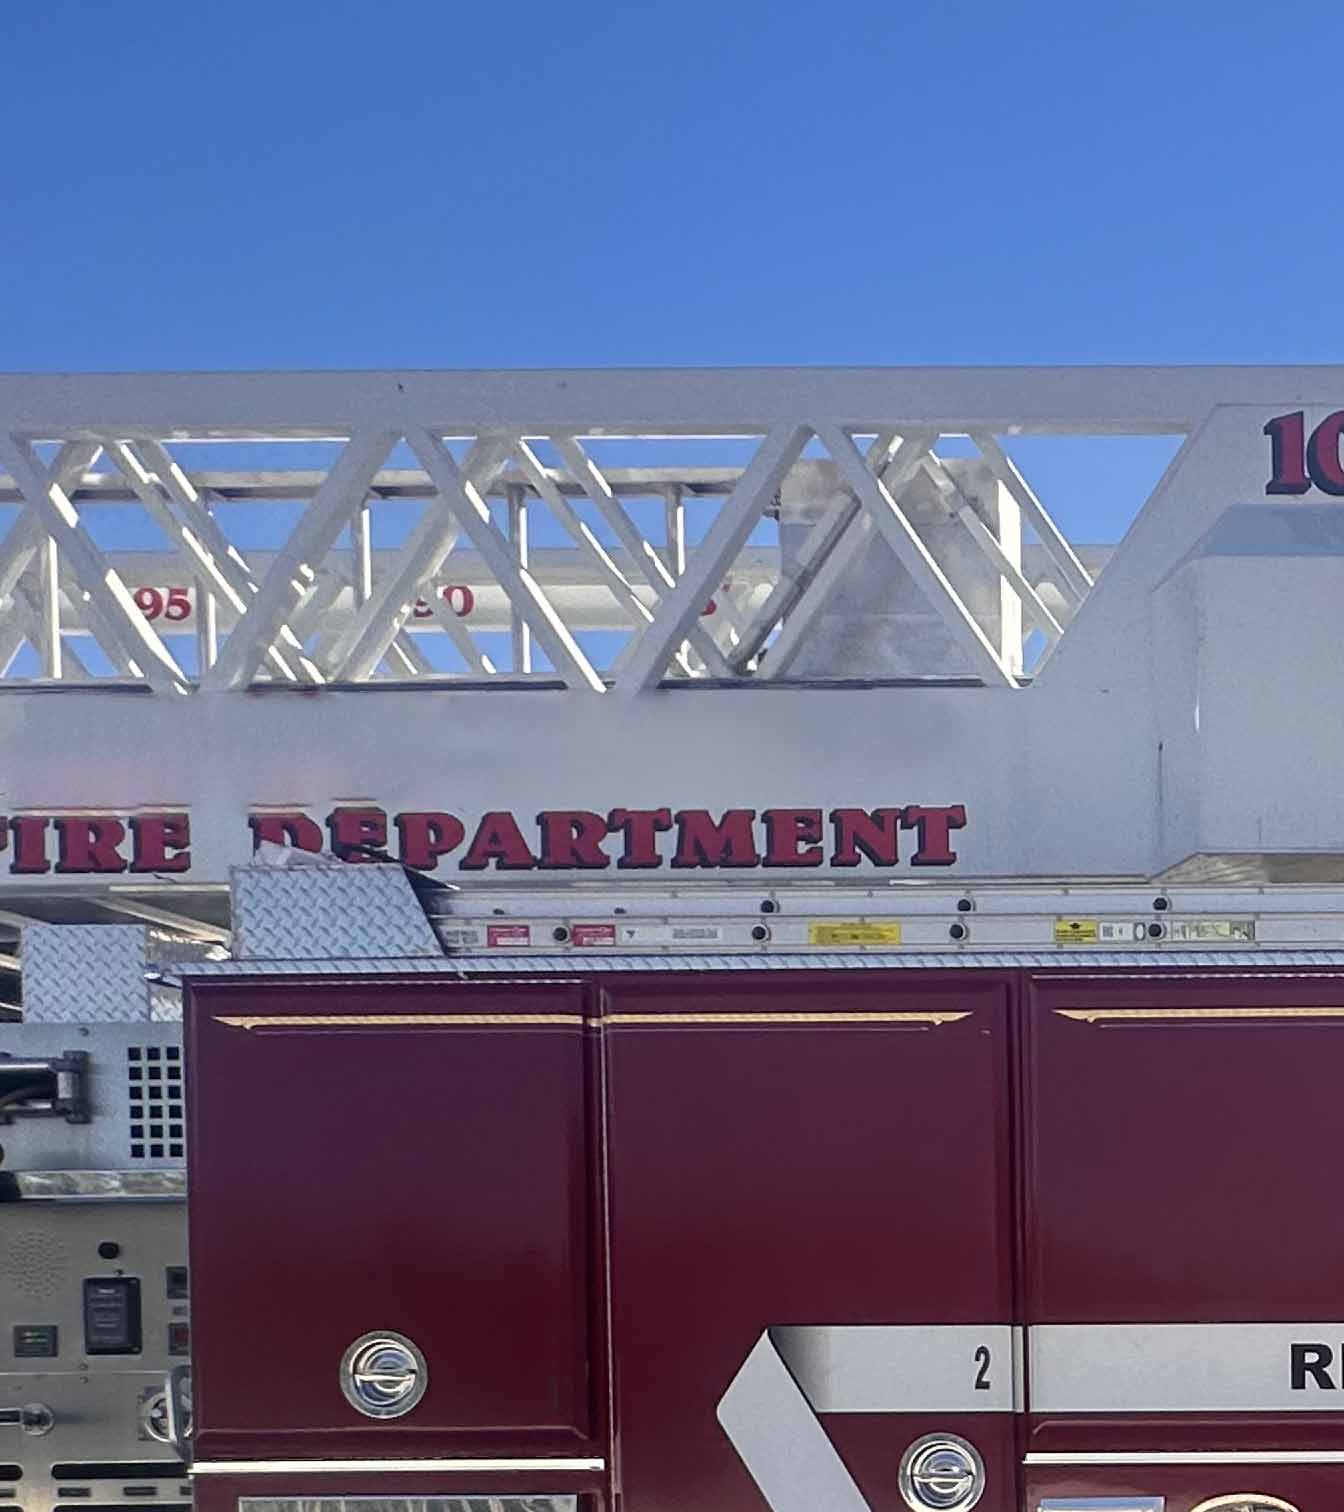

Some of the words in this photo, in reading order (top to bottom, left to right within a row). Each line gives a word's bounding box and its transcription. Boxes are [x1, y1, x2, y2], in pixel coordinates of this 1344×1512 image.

[133, 587, 193, 622] 95
[0, 813, 192, 874] IRE
[247, 803, 967, 873] DEPARTMENT
[973, 1345, 991, 1390] 2
